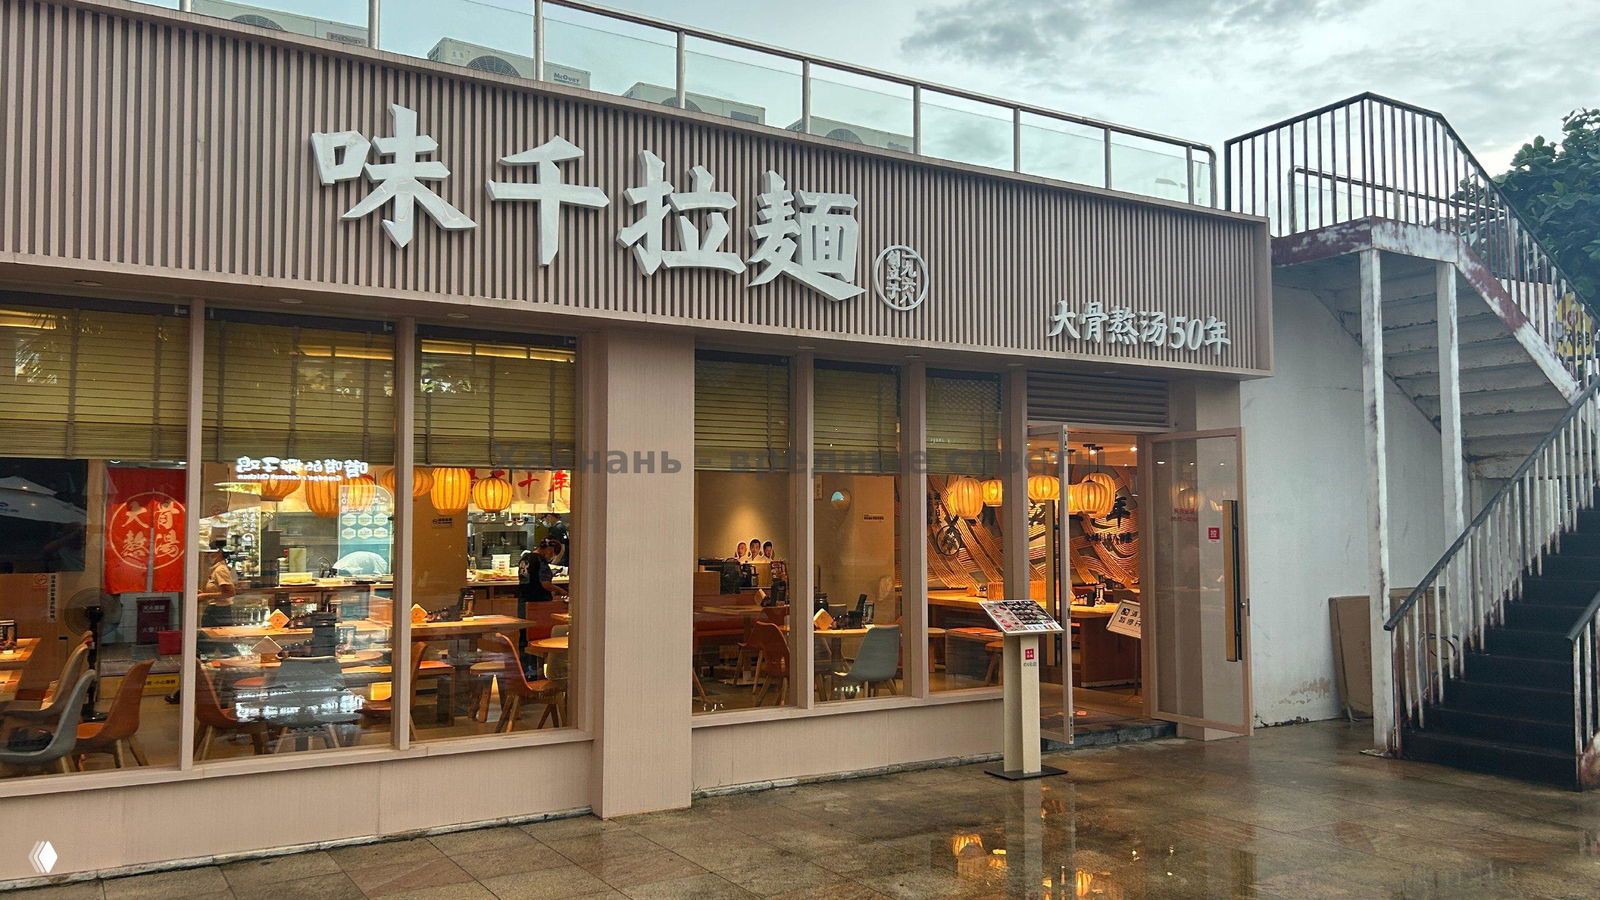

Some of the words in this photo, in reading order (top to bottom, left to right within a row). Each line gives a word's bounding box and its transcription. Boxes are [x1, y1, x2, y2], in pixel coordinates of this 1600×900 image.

[311, 103, 866, 302] 味千拉麵
[900, 254, 918, 305] 一九六八
[1047, 299, 1231, 355] 大骨熬汤50年
